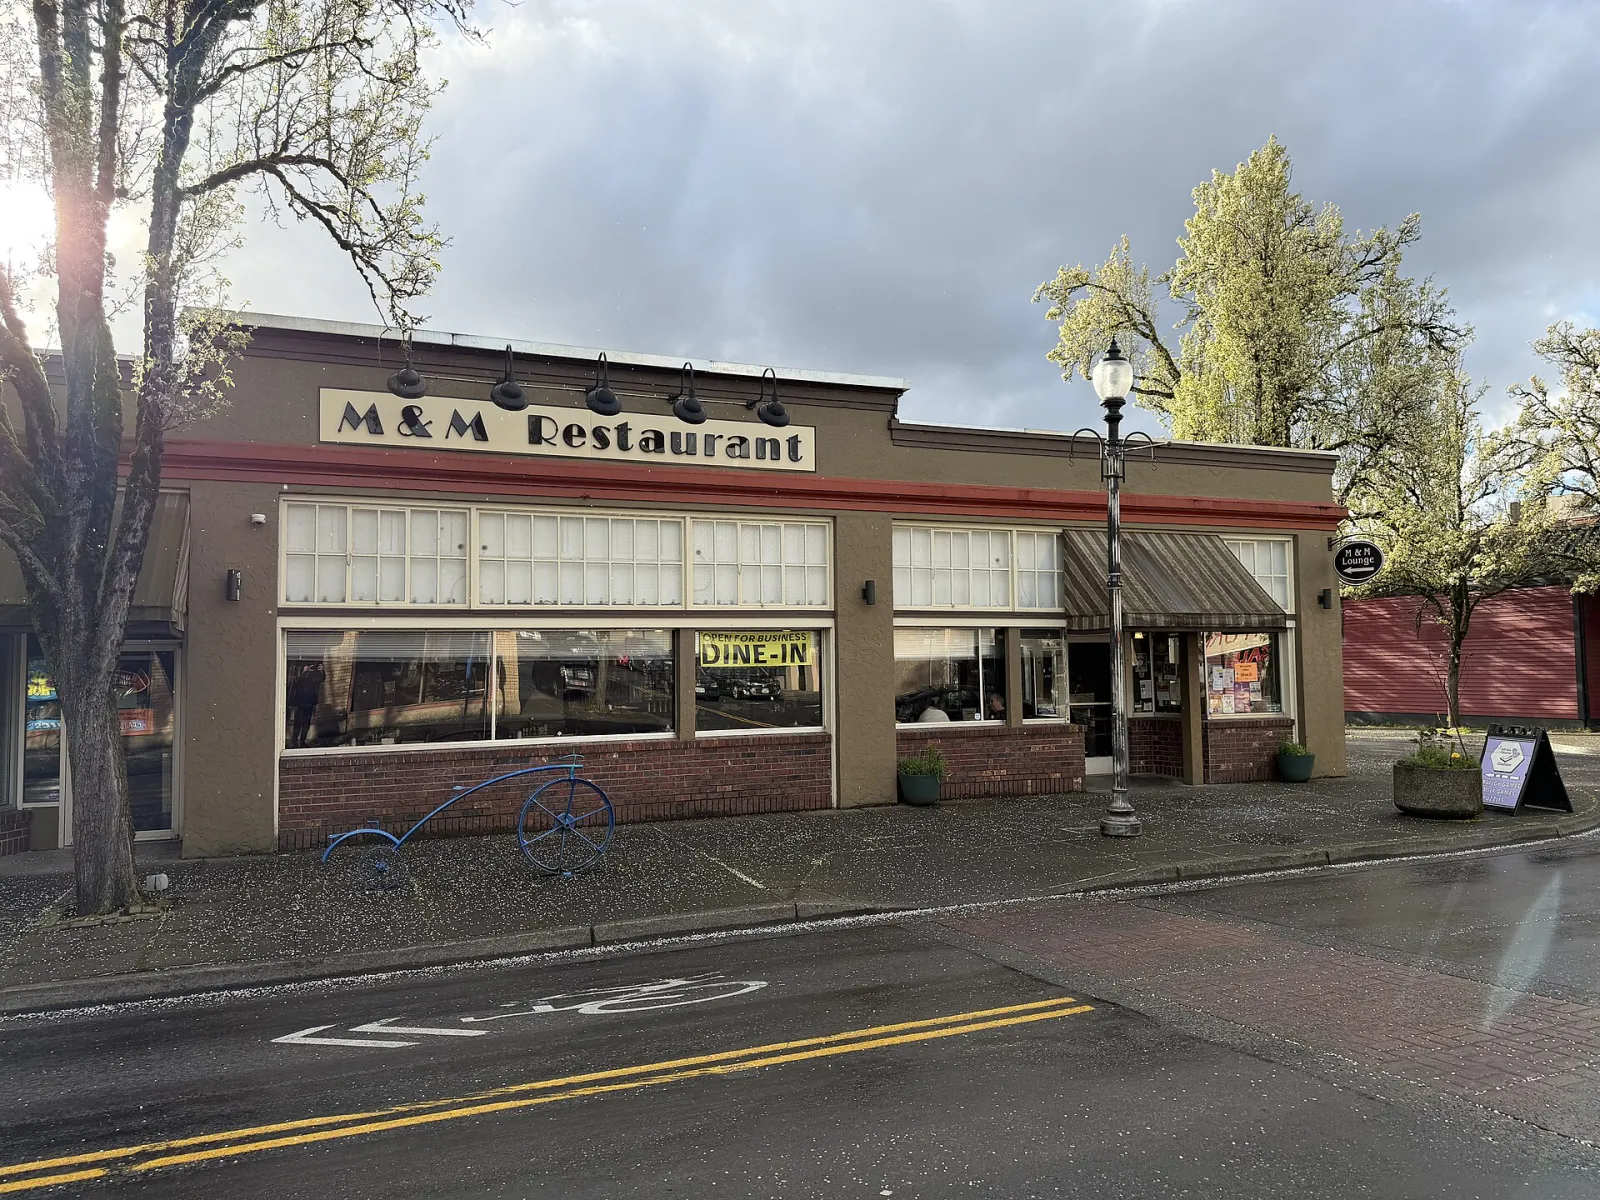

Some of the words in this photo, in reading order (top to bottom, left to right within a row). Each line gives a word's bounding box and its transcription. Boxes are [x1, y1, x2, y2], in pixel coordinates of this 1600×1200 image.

[337, 400, 385, 435] M
[397, 404, 433, 438] &
[445, 408, 489, 442] M
[527, 413, 803, 463] Restaurant
[1364, 548, 1370, 556] M
[1342, 556, 1375, 566] Lounge
[703, 633, 732, 642] OPEN
[734, 634, 756, 642] FOR
[757, 632, 807, 642] BUSINESS
[702, 643, 807, 664] DINE-IN
